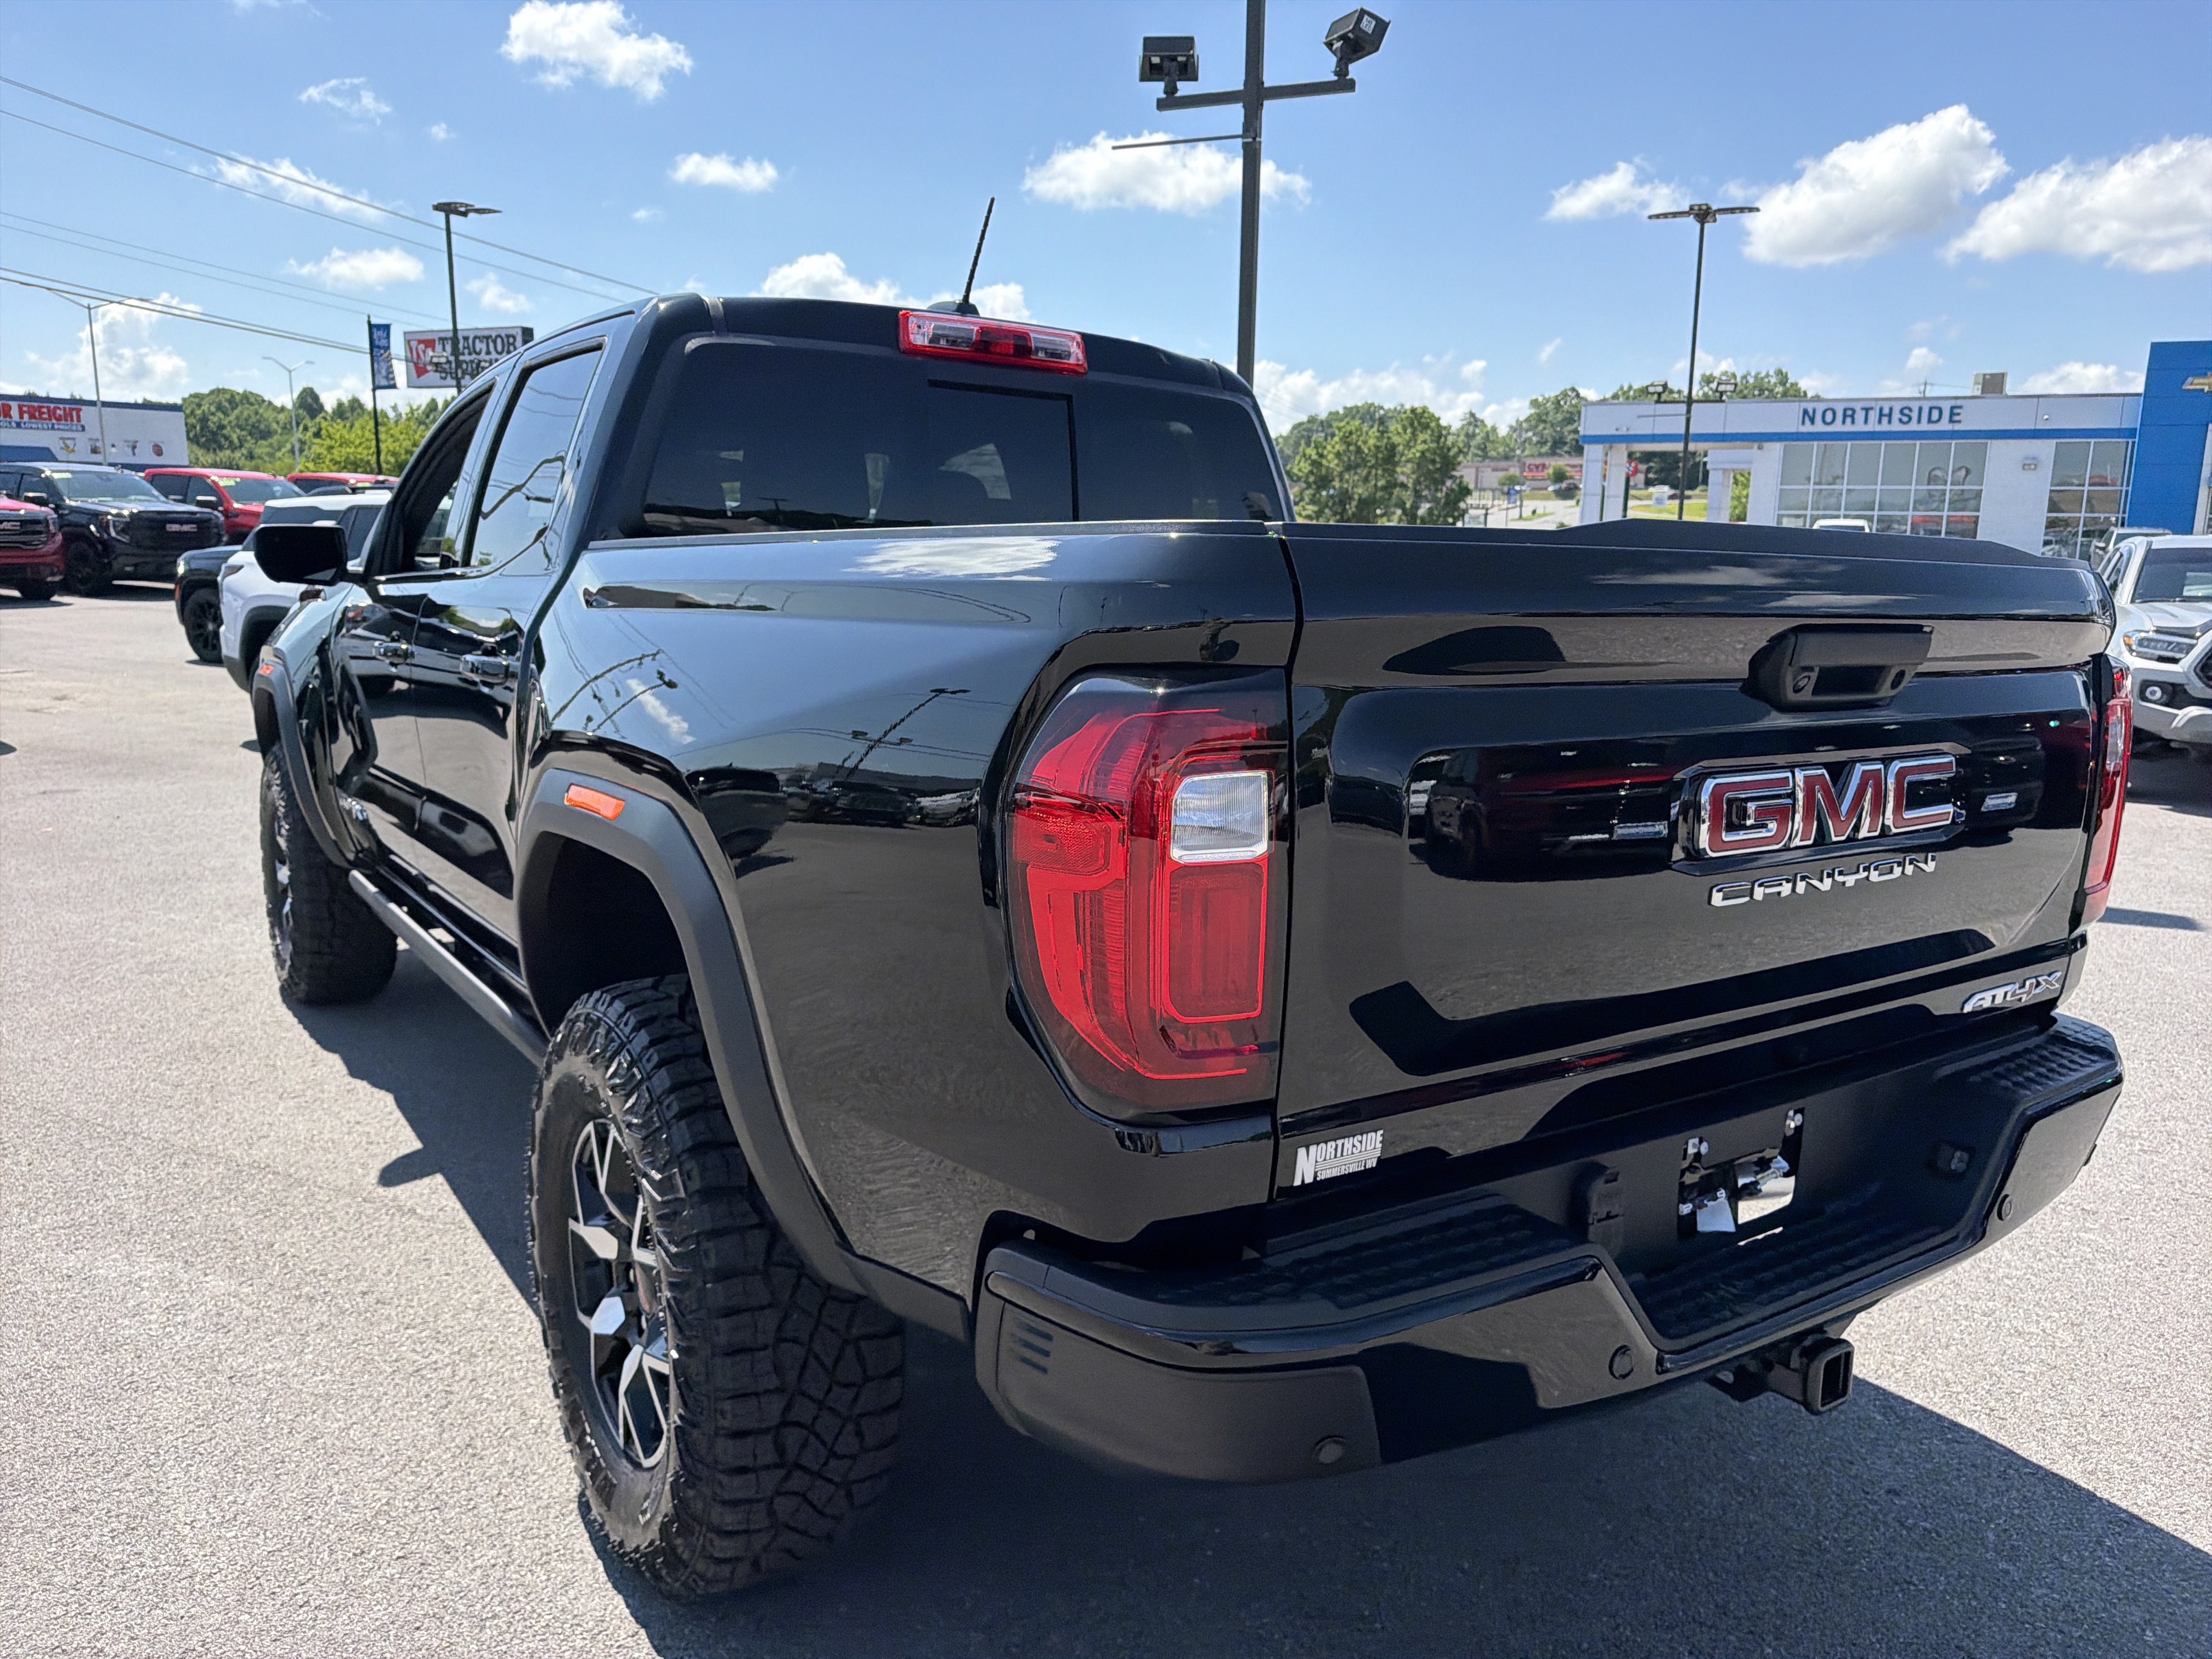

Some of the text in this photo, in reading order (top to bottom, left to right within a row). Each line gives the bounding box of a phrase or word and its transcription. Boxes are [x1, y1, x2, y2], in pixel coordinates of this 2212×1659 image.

[18, 403, 82, 423] FREIGHT
[1801, 405, 1963, 426] NORTHSIDE
[1700, 754, 1956, 857] GMC
[1710, 853, 1937, 907] CANYON
[1962, 971, 2062, 1013] AT4X
[1293, 1130, 1384, 1186] NORTHSIDE
[1317, 1156, 1378, 1181] SUMMERSVILLE WV
